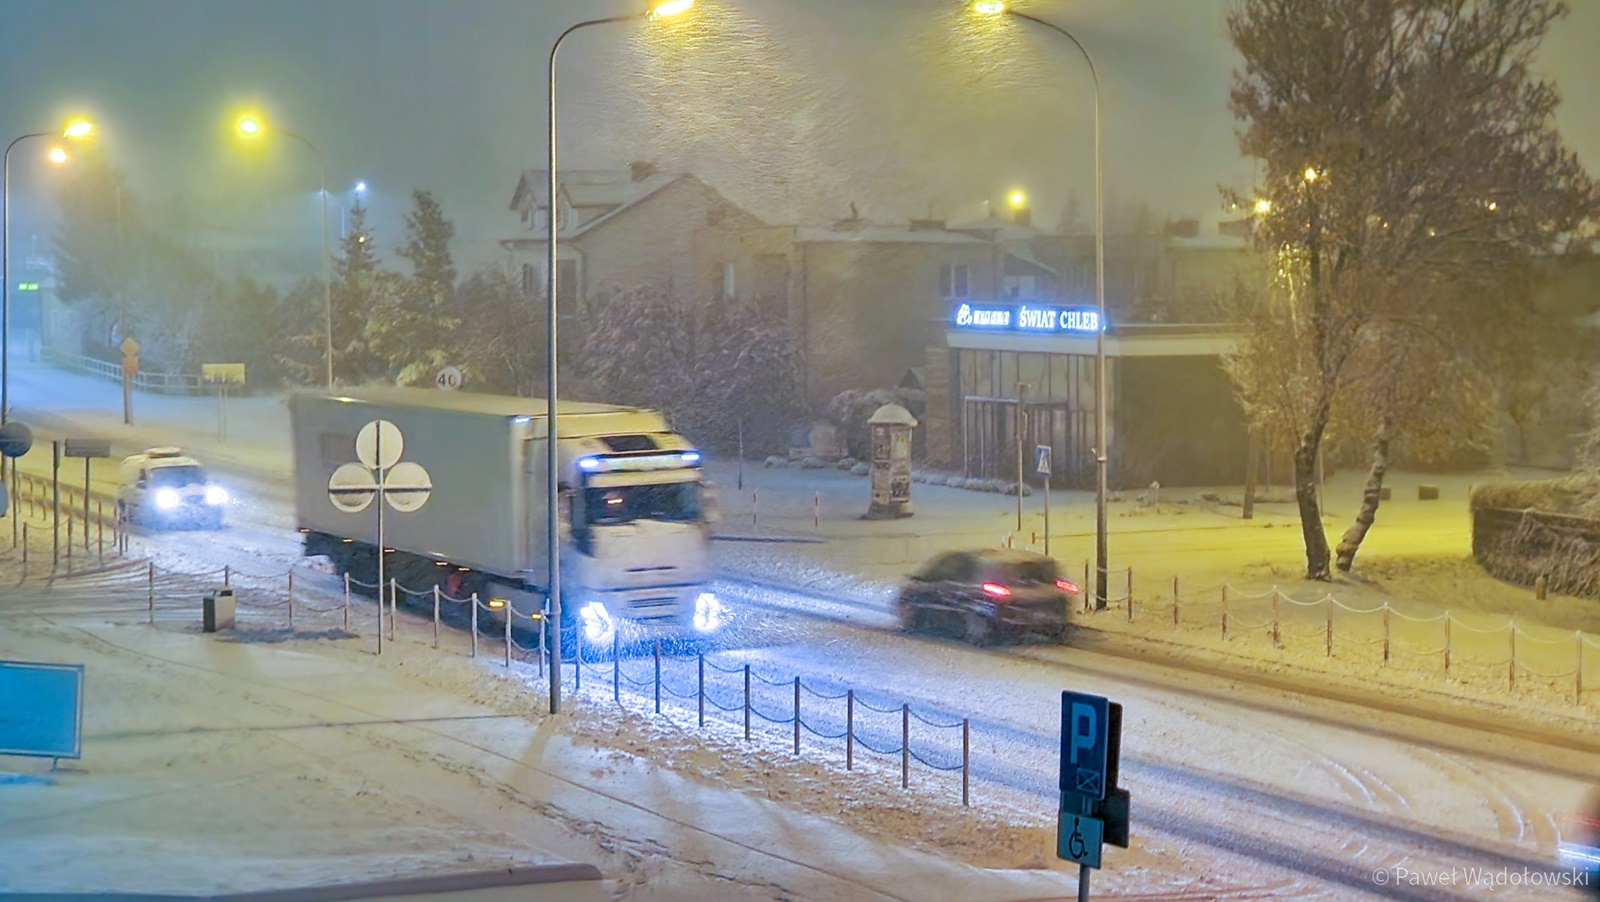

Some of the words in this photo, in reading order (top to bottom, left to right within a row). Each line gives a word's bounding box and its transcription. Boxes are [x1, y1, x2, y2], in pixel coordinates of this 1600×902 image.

[1019, 305, 1056, 328] ŚWIAT
[1060, 312, 1106, 331] CHLEB
[438, 373, 457, 387] 40
[1070, 701, 1097, 764] P
